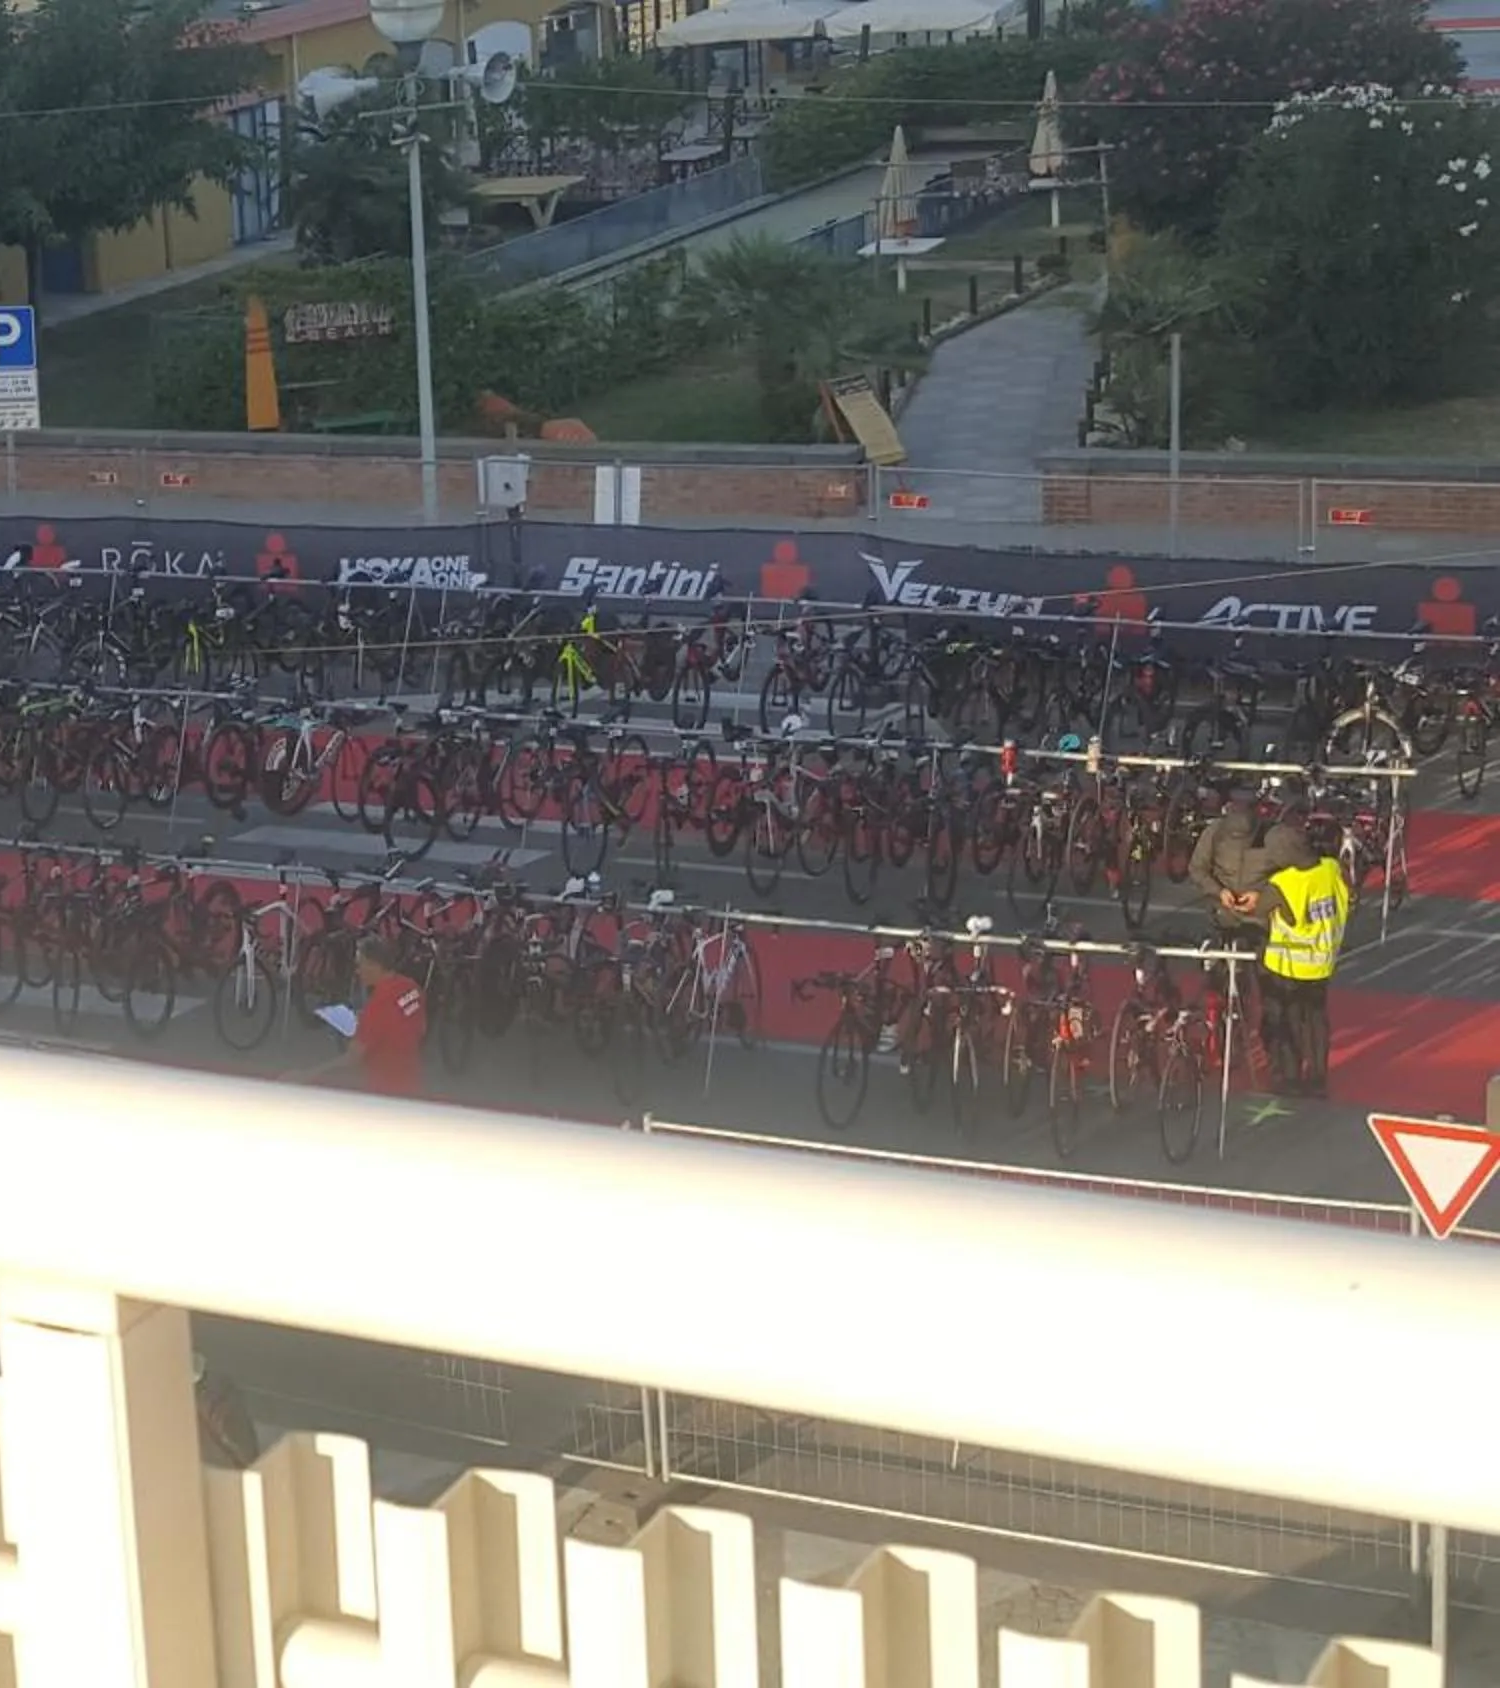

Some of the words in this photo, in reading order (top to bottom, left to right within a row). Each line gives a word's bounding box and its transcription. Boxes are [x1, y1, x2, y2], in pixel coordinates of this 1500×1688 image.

[431, 556, 470, 572] ONE
[560, 556, 718, 597] Santini
[1199, 595, 1378, 635] ACTIVE
